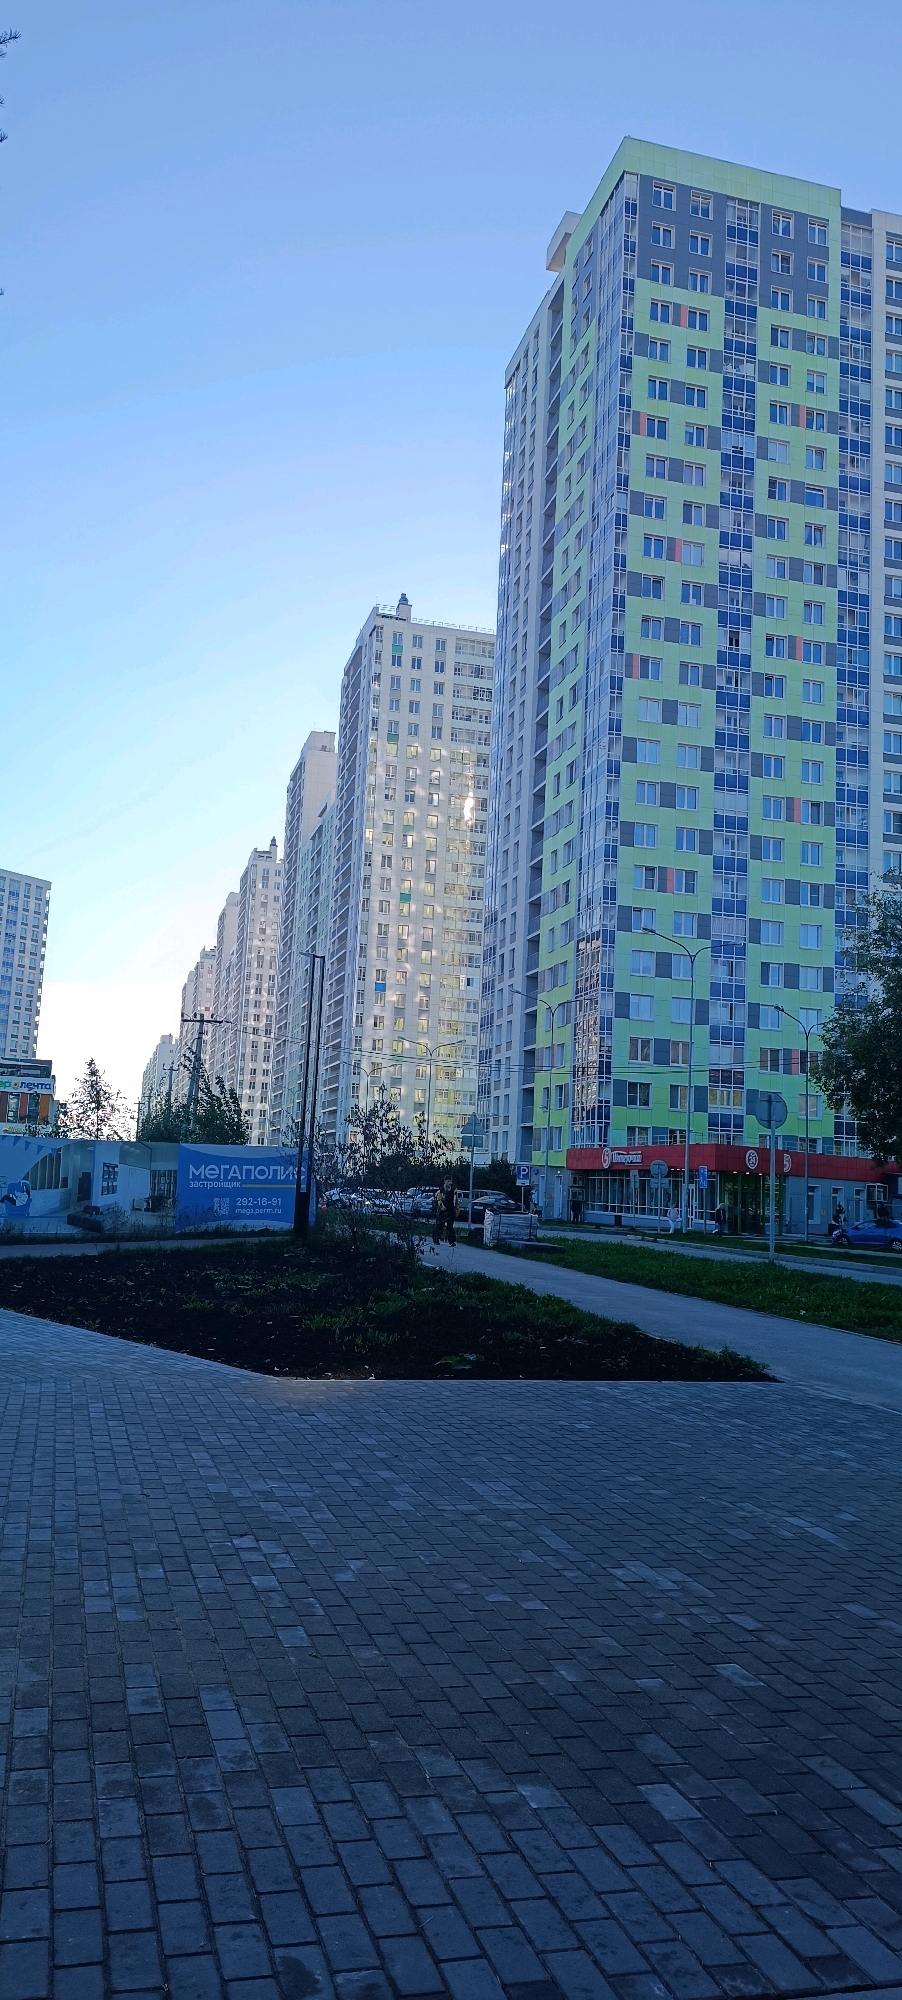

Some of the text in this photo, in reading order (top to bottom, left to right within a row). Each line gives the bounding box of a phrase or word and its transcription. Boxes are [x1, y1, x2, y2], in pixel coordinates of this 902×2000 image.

[520, 1166, 529, 1179] P
[189, 1180, 241, 1190] застройщик
[235, 1197, 282, 1206] 292-16-91
[235, 1207, 282, 1216] mega.perm.ru
